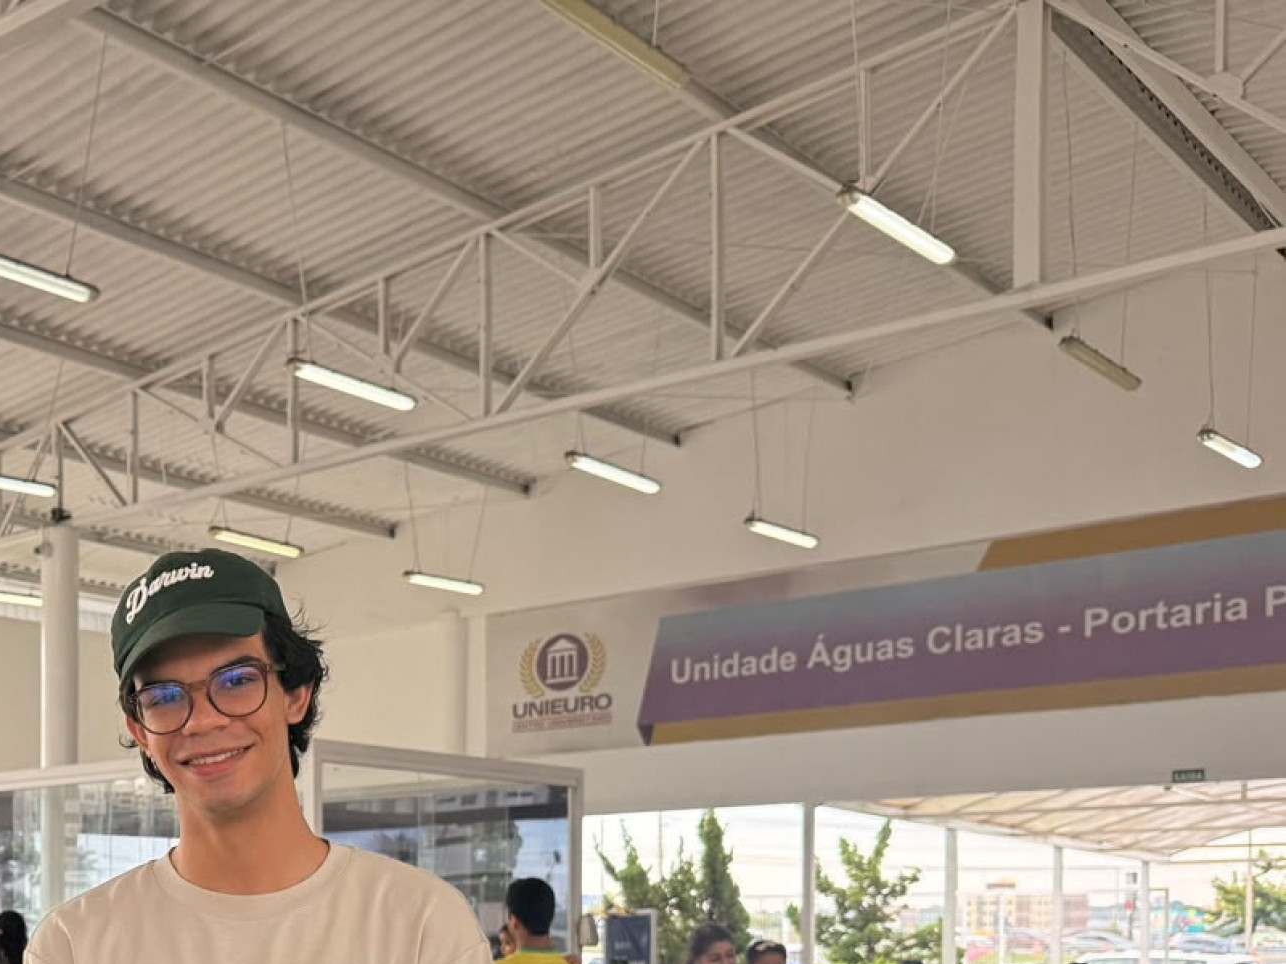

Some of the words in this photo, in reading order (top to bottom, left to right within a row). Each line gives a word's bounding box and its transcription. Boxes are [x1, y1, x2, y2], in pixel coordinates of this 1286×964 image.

[126, 562, 214, 625] Darwin
[670, 646, 797, 684] Unidade
[807, 633, 914, 673] Águas
[926, 621, 1045, 655] Claras
[1083, 593, 1248, 638] Portaria
[512, 693, 613, 719] UNIEURO
